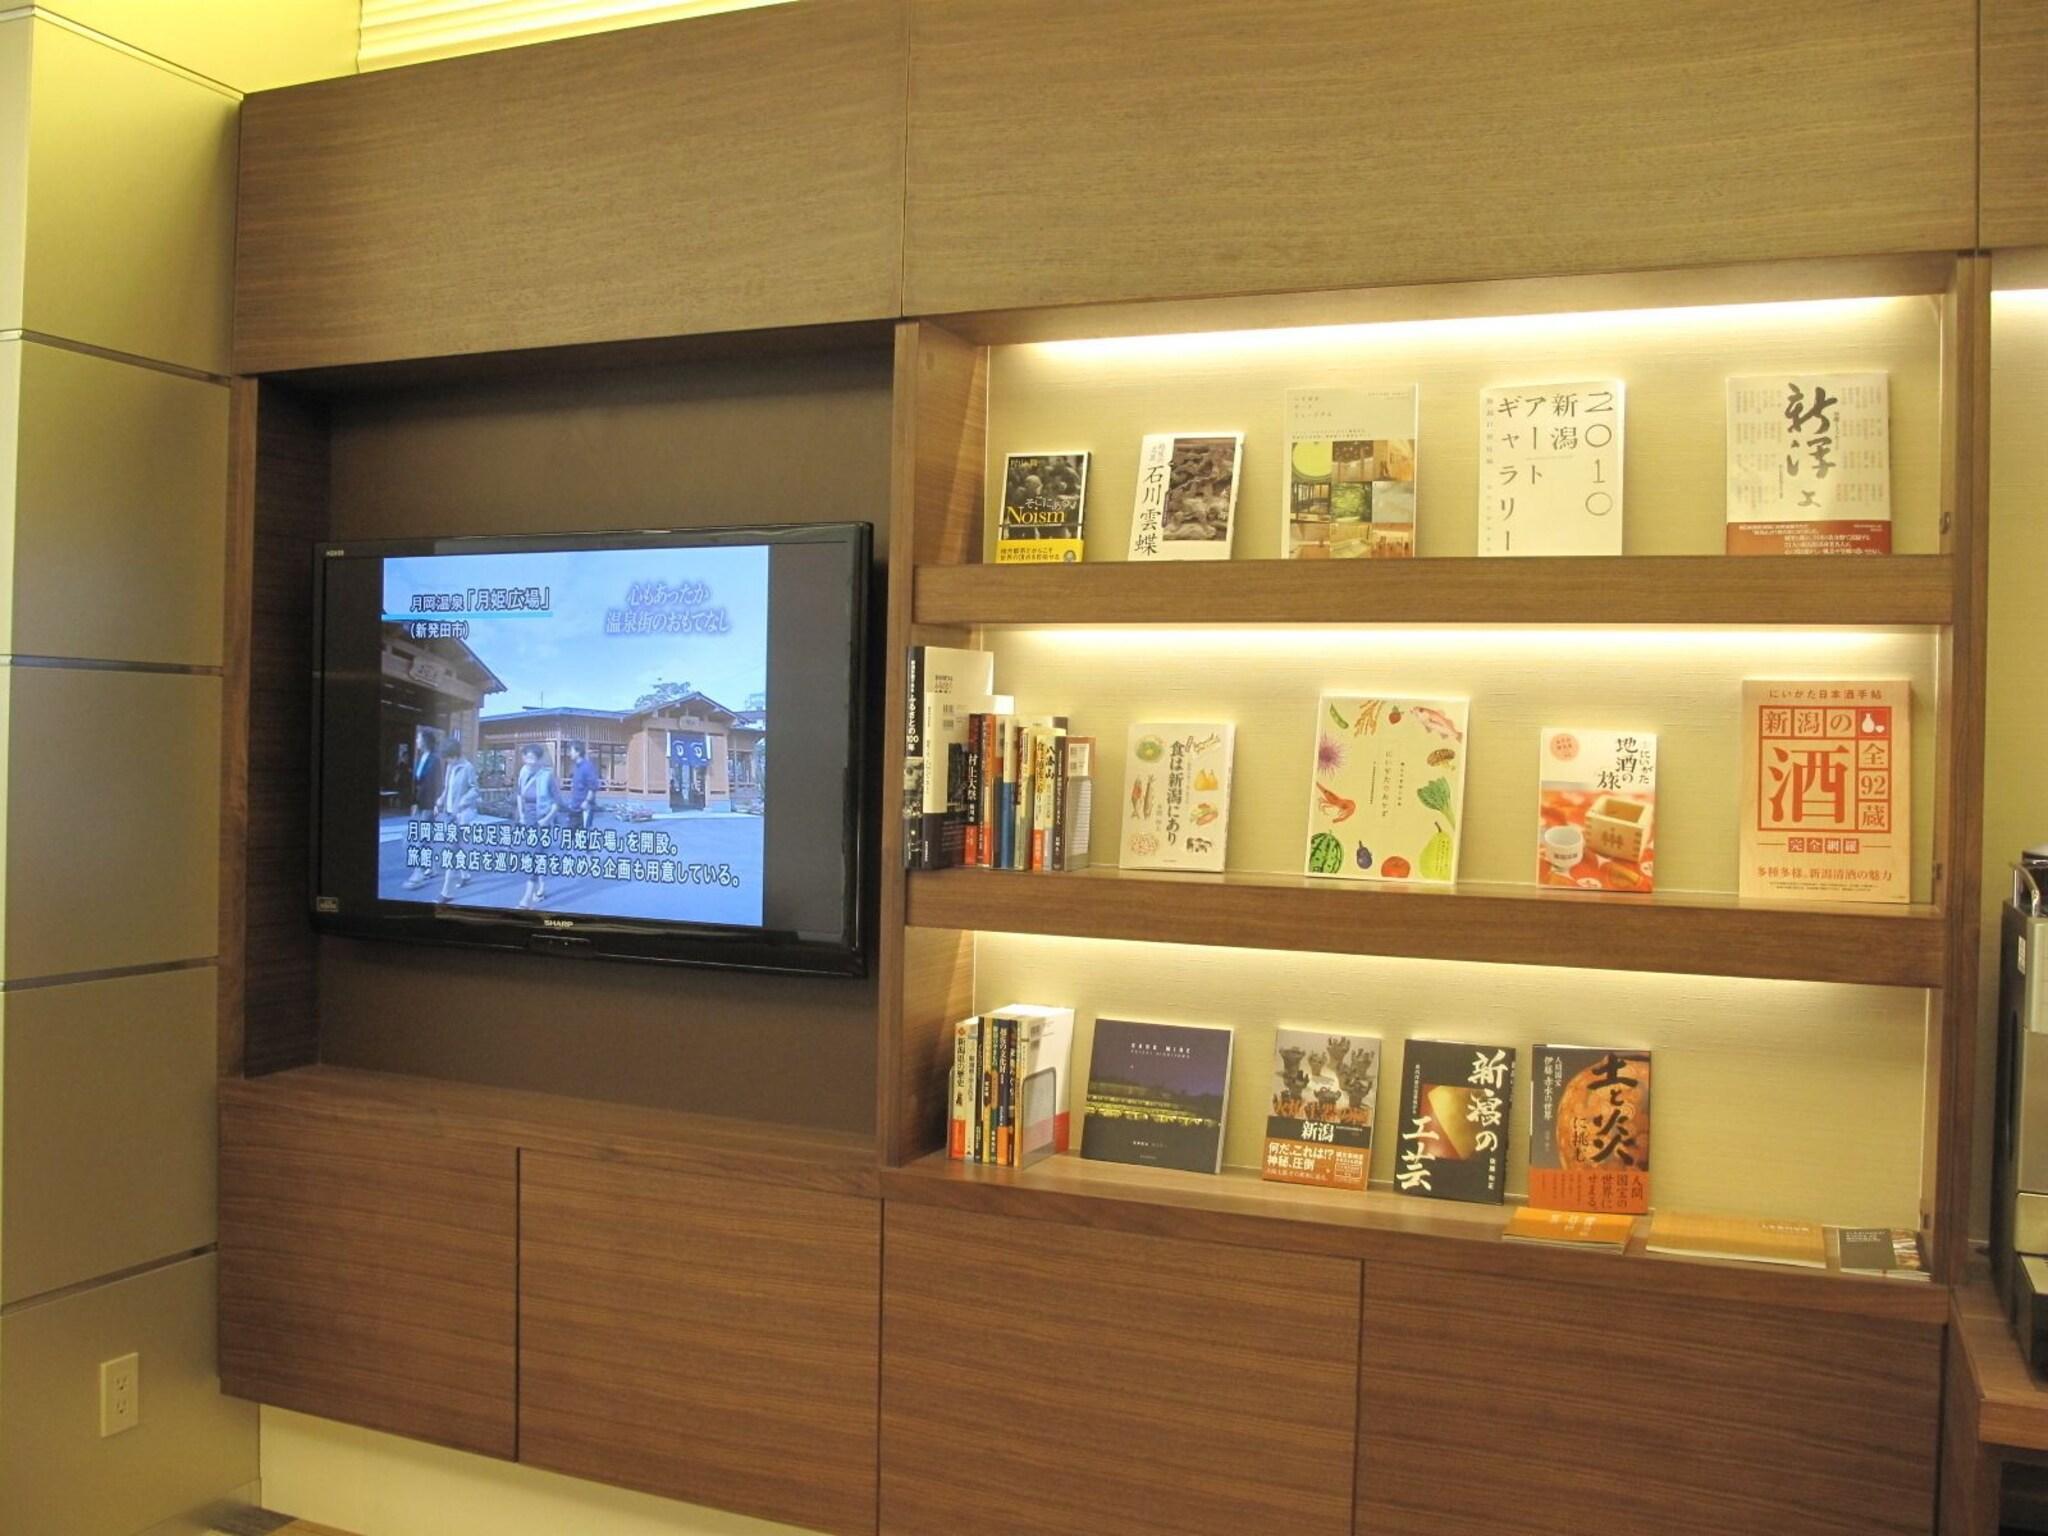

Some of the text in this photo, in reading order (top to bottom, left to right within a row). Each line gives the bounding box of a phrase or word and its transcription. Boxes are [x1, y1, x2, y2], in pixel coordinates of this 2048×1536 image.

[1525, 396, 1547, 485] アート
[1551, 392, 1578, 450] 新潟
[1498, 395, 1523, 551] ギャラリー
[1007, 506, 1065, 525] Noism
[629, 583, 711, 607] 心もあったか
[606, 610, 731, 634] 温泉街のおもてなし
[1764, 710, 1853, 735] 新潟の
[1597, 770, 1621, 790] 旅
[1615, 736, 1639, 784] 地酒の
[1638, 749, 1653, 785] にいがた
[1166, 740, 1184, 845] 食は新潟にあり
[1767, 745, 1850, 824] 酒
[544, 920, 574, 928] SHARP
[1466, 1049, 1509, 1152] 新潟の
[1301, 1120, 1335, 1142] 新潟
[1396, 1116, 1440, 1191] 工芸
